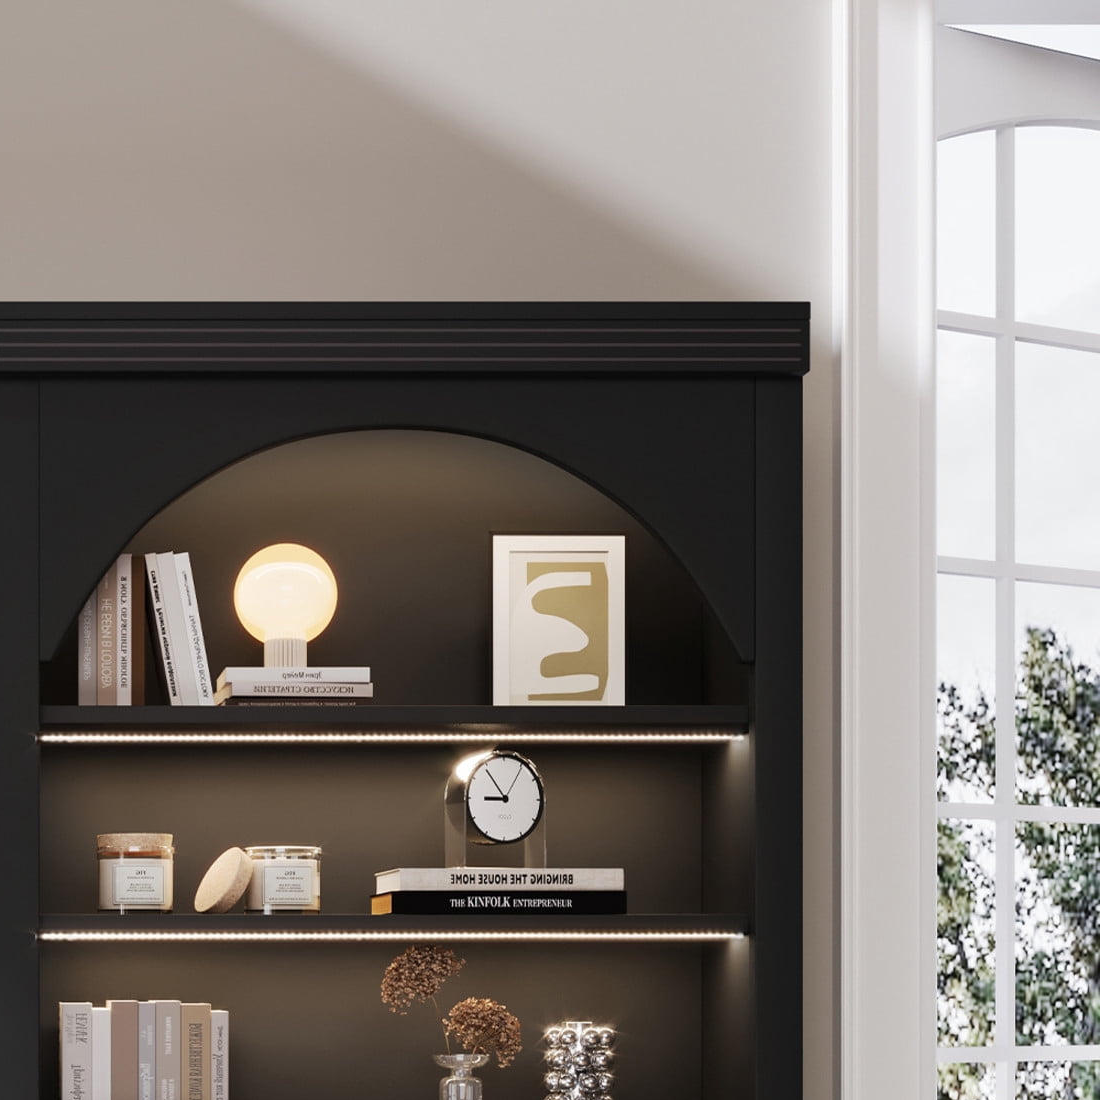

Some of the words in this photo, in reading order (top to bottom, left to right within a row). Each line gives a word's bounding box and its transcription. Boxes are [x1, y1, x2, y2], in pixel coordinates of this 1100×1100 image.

[450, 898, 466, 908] THE
[466, 896, 511, 908] KINFOLK
[512, 899, 573, 908] ENTREPRENEUR
